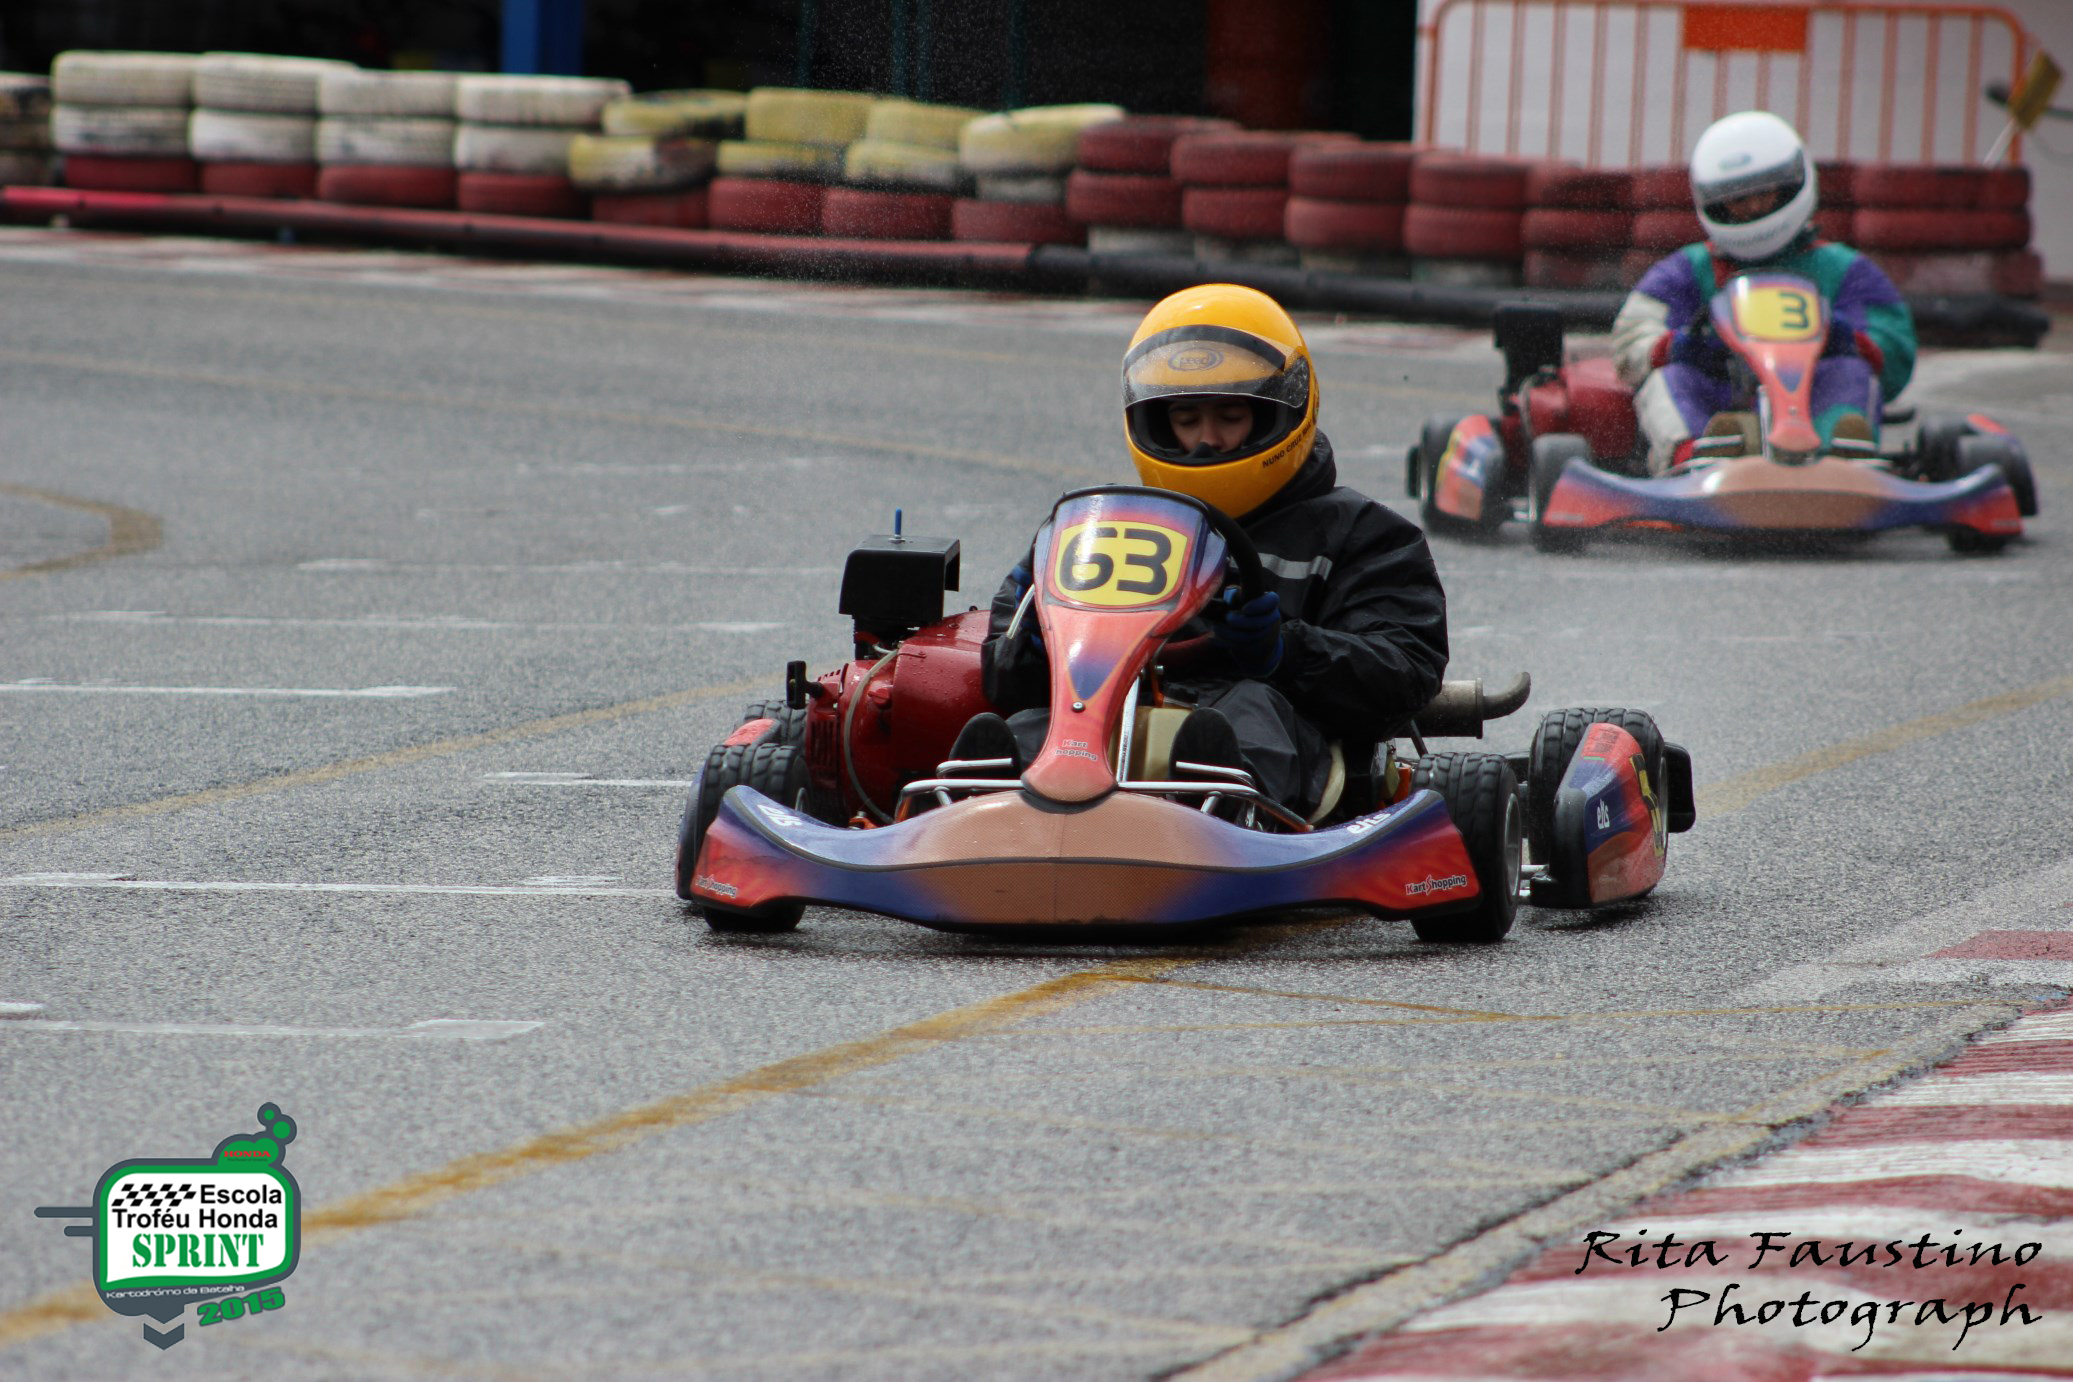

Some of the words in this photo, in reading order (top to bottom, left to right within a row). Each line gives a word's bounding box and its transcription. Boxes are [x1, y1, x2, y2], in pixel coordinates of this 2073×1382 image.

[1779, 290, 1809, 329] 3
[1262, 450, 1285, 468] NUNO
[1060, 527, 1171, 595] 63
[1062, 739, 1088, 748] Kart
